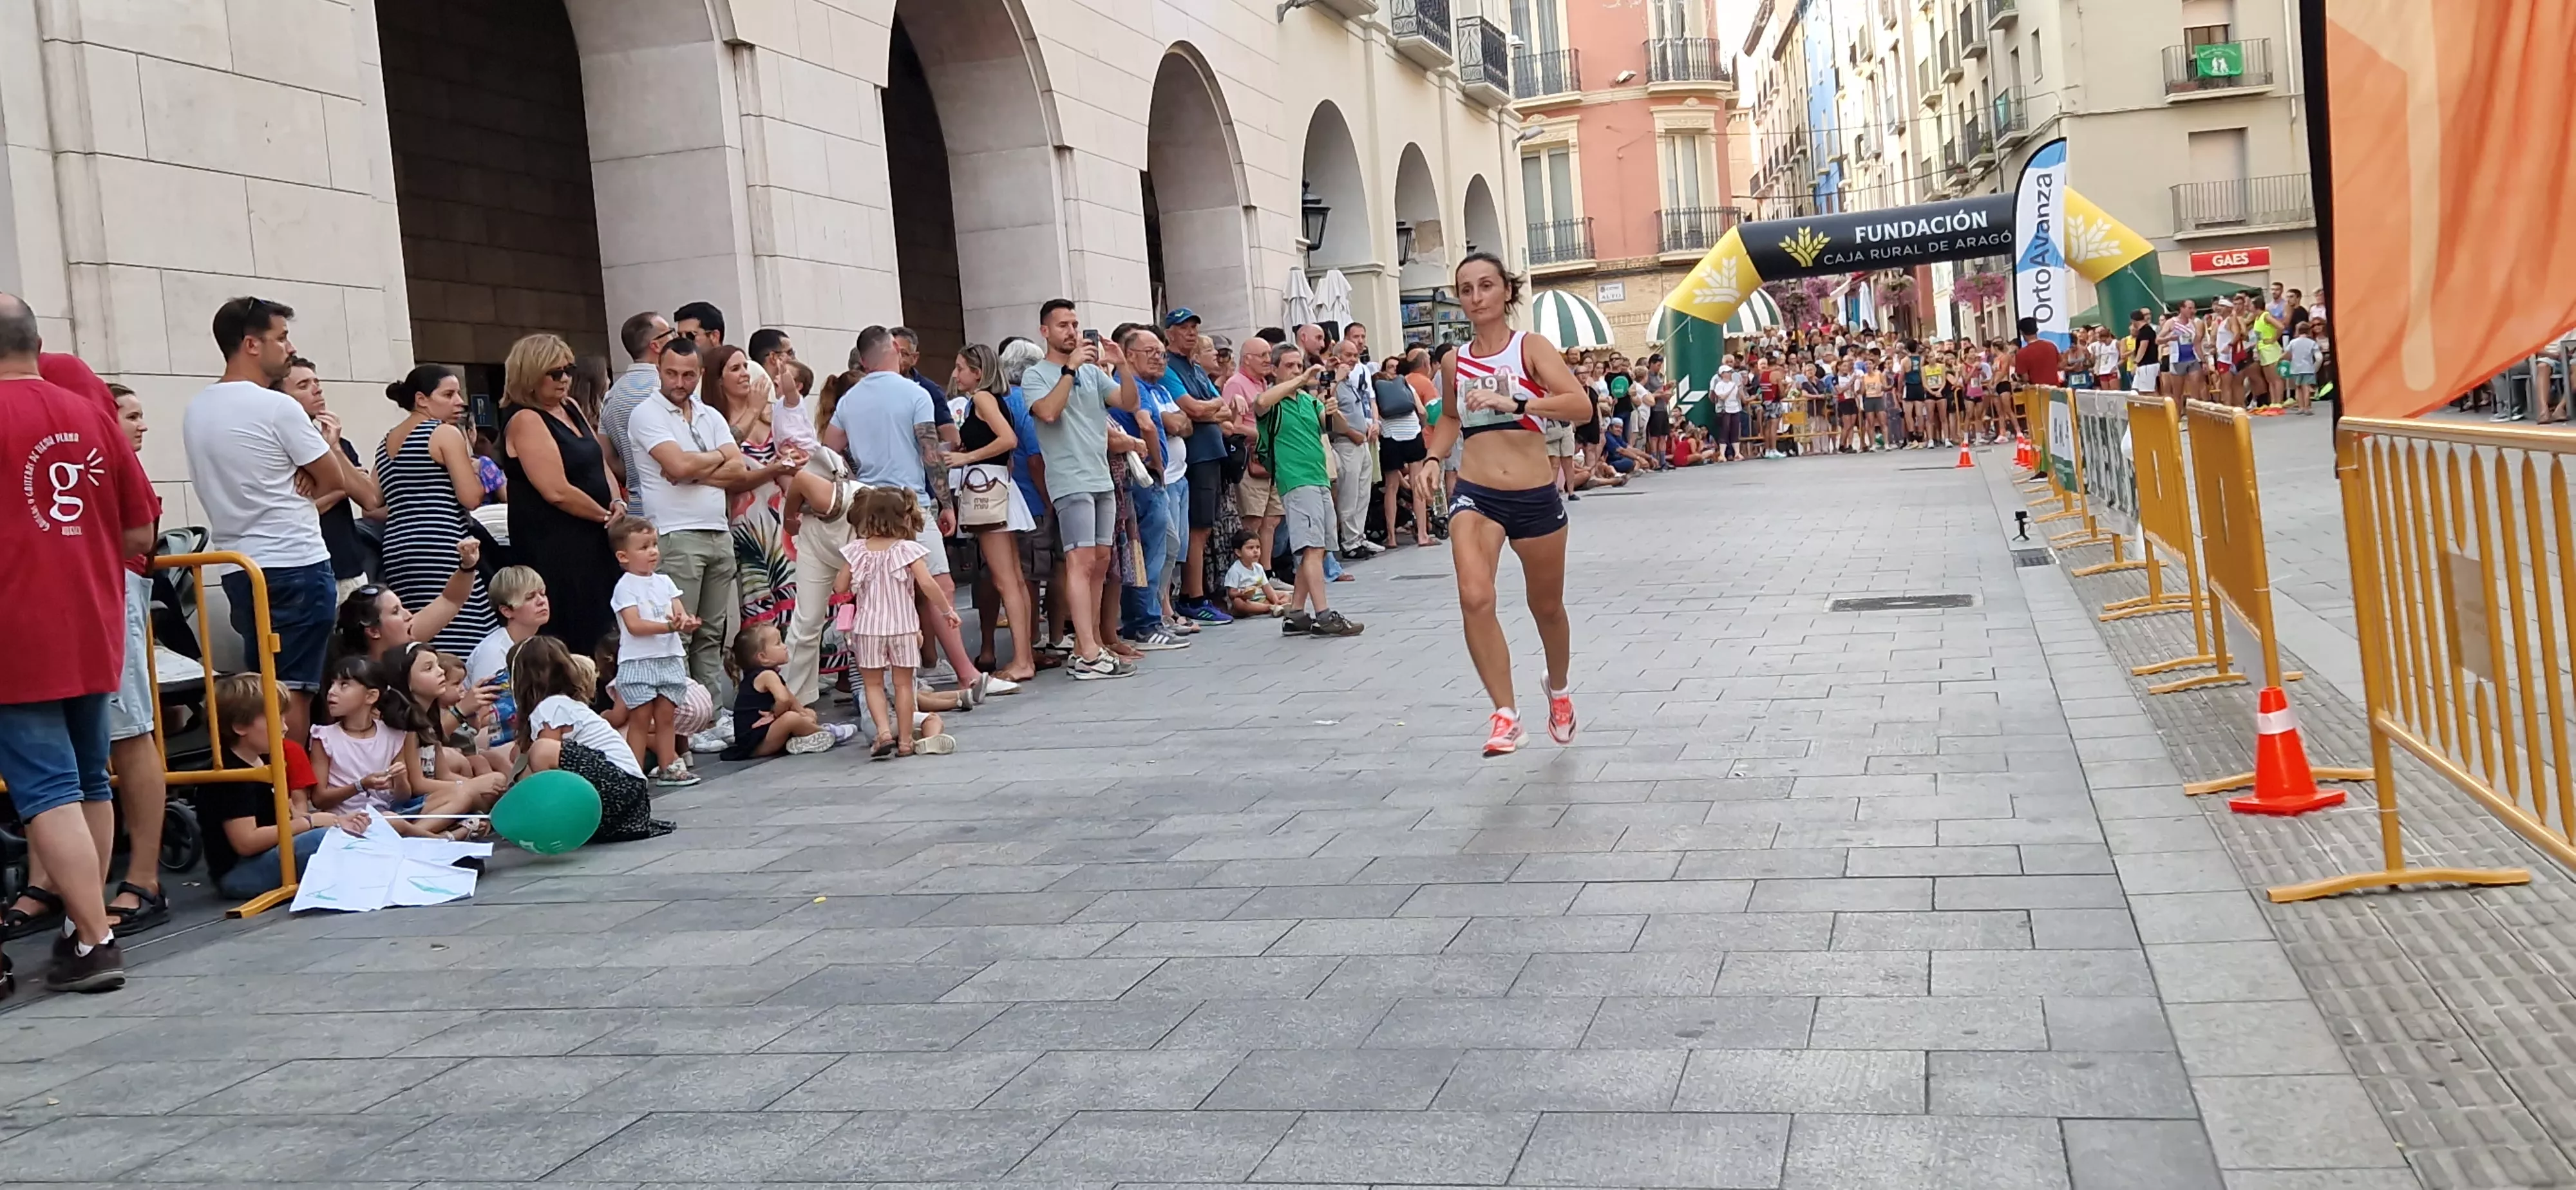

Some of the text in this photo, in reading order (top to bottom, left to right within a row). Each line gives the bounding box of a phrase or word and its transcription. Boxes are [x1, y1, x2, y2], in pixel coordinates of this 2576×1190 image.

[1855, 209, 1988, 244] FUNDACIÓN
[1824, 229, 2012, 265] CAJA RURAL DE ARAGÓ
[2030, 173, 2053, 323] OrtoAvanza
[2212, 252, 2249, 267] GAES
